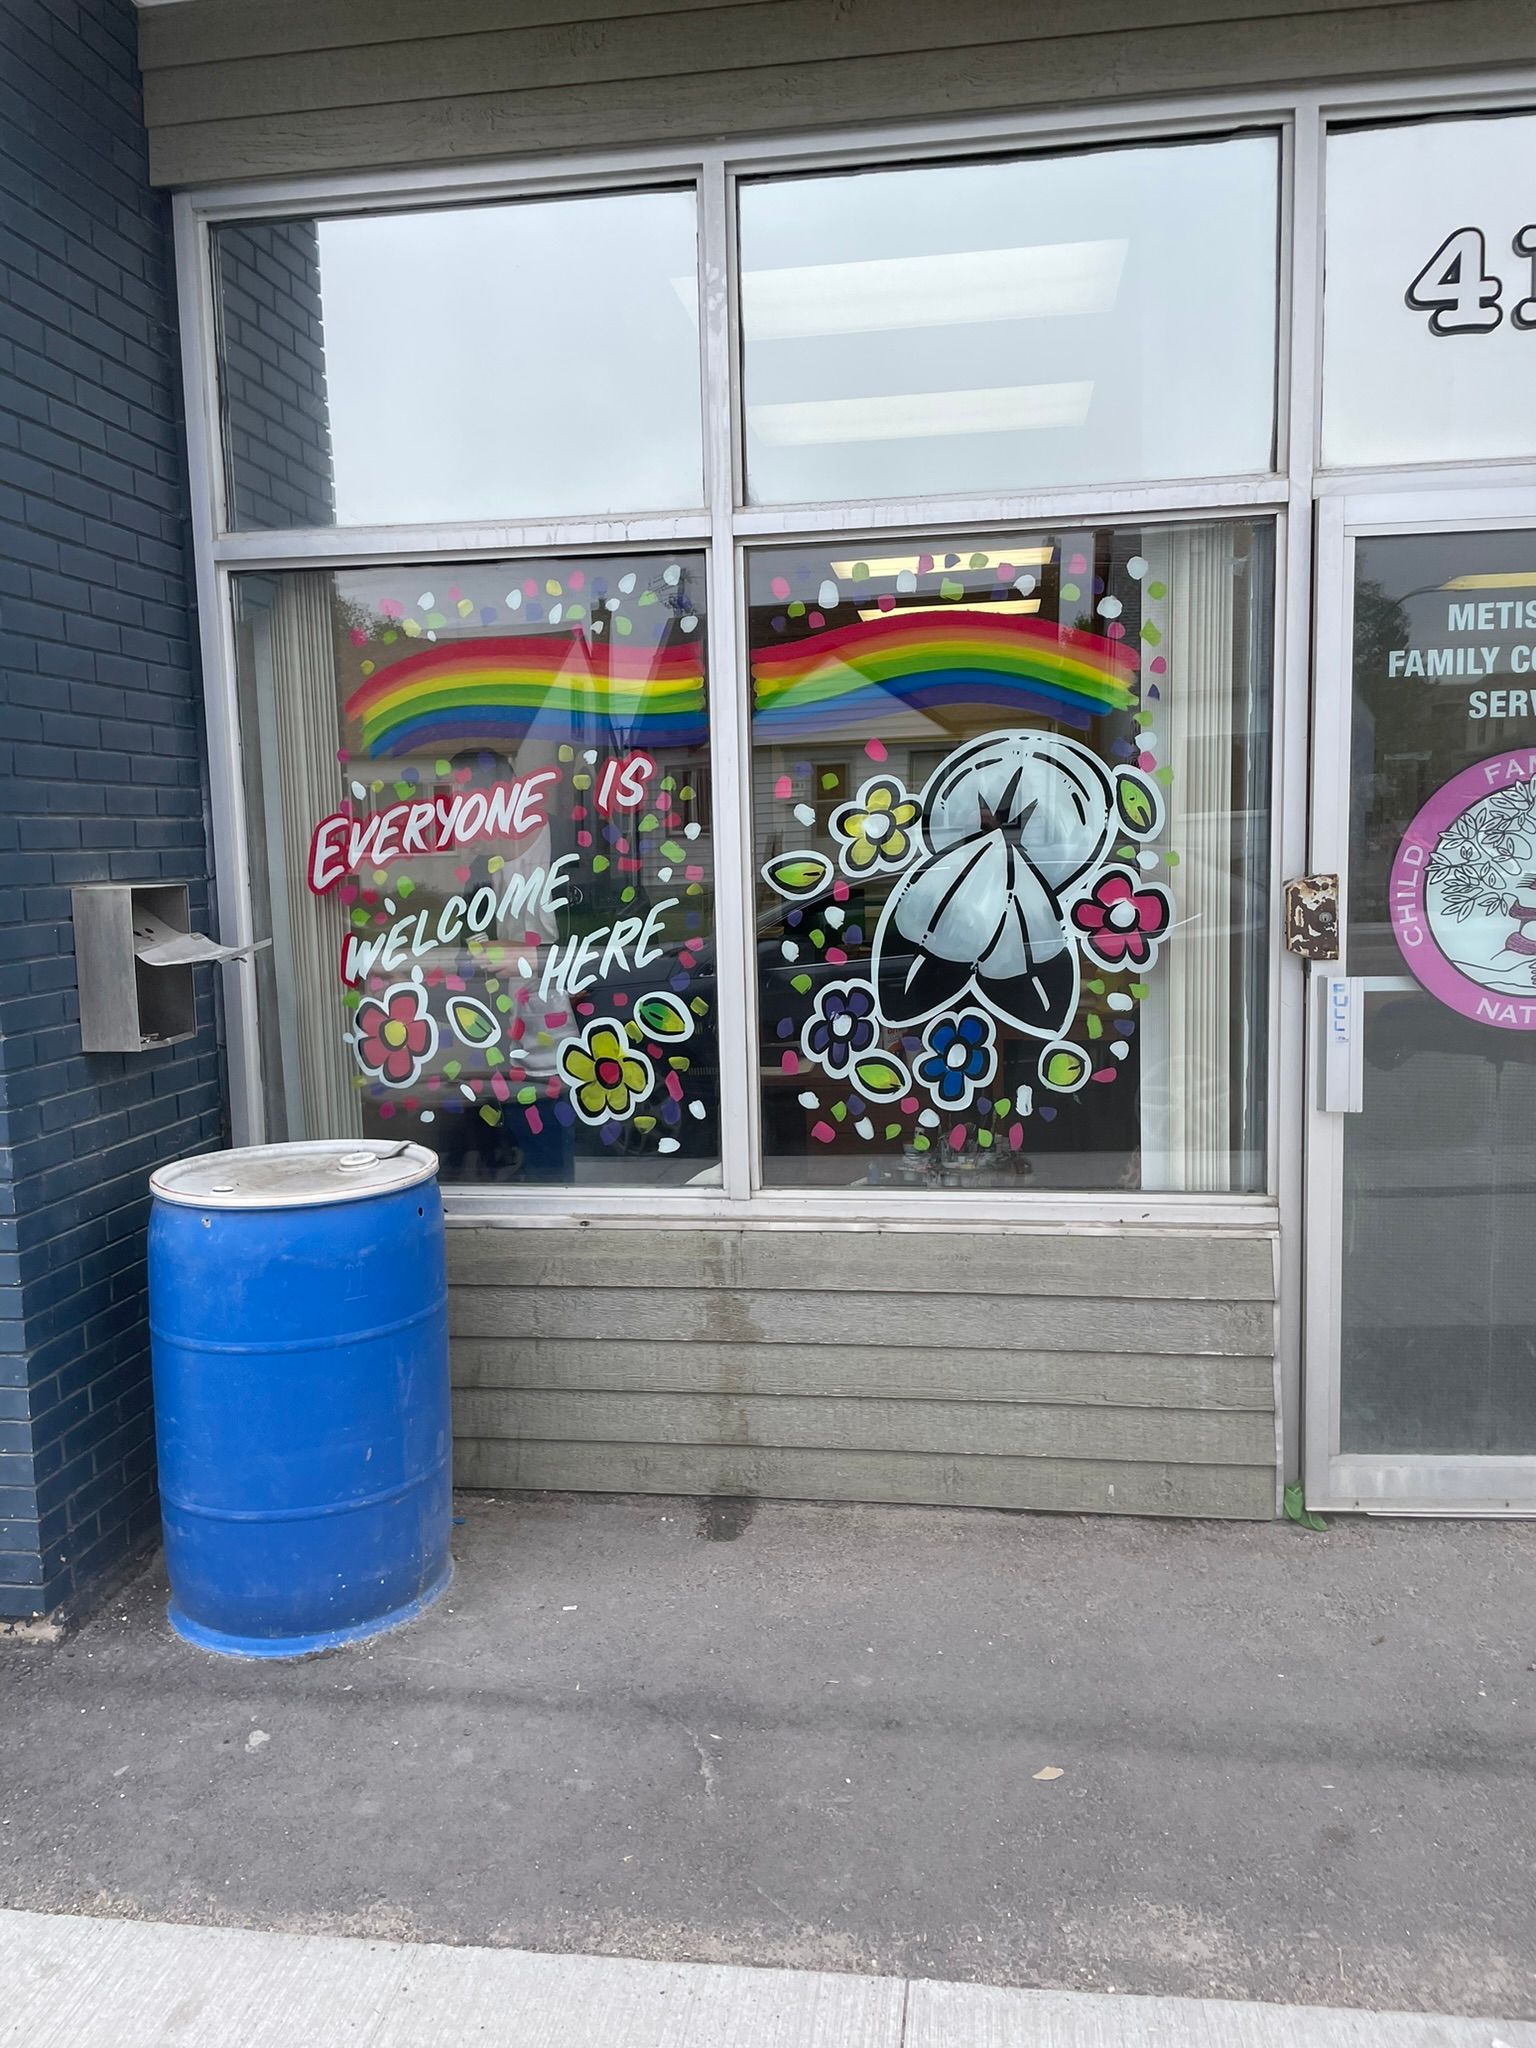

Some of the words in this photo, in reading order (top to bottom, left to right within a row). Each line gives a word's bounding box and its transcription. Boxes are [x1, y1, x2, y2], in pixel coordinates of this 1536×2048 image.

[1388, 646, 1501, 677] FAMILY
[1510, 645, 1536, 674] C
[1448, 600, 1536, 631] METIS
[312, 770, 558, 892] EVERYONE
[598, 754, 655, 812] IS
[345, 853, 580, 985] WELCOME
[1397, 845, 1424, 947] CHILD
[538, 897, 680, 1003] HERE
